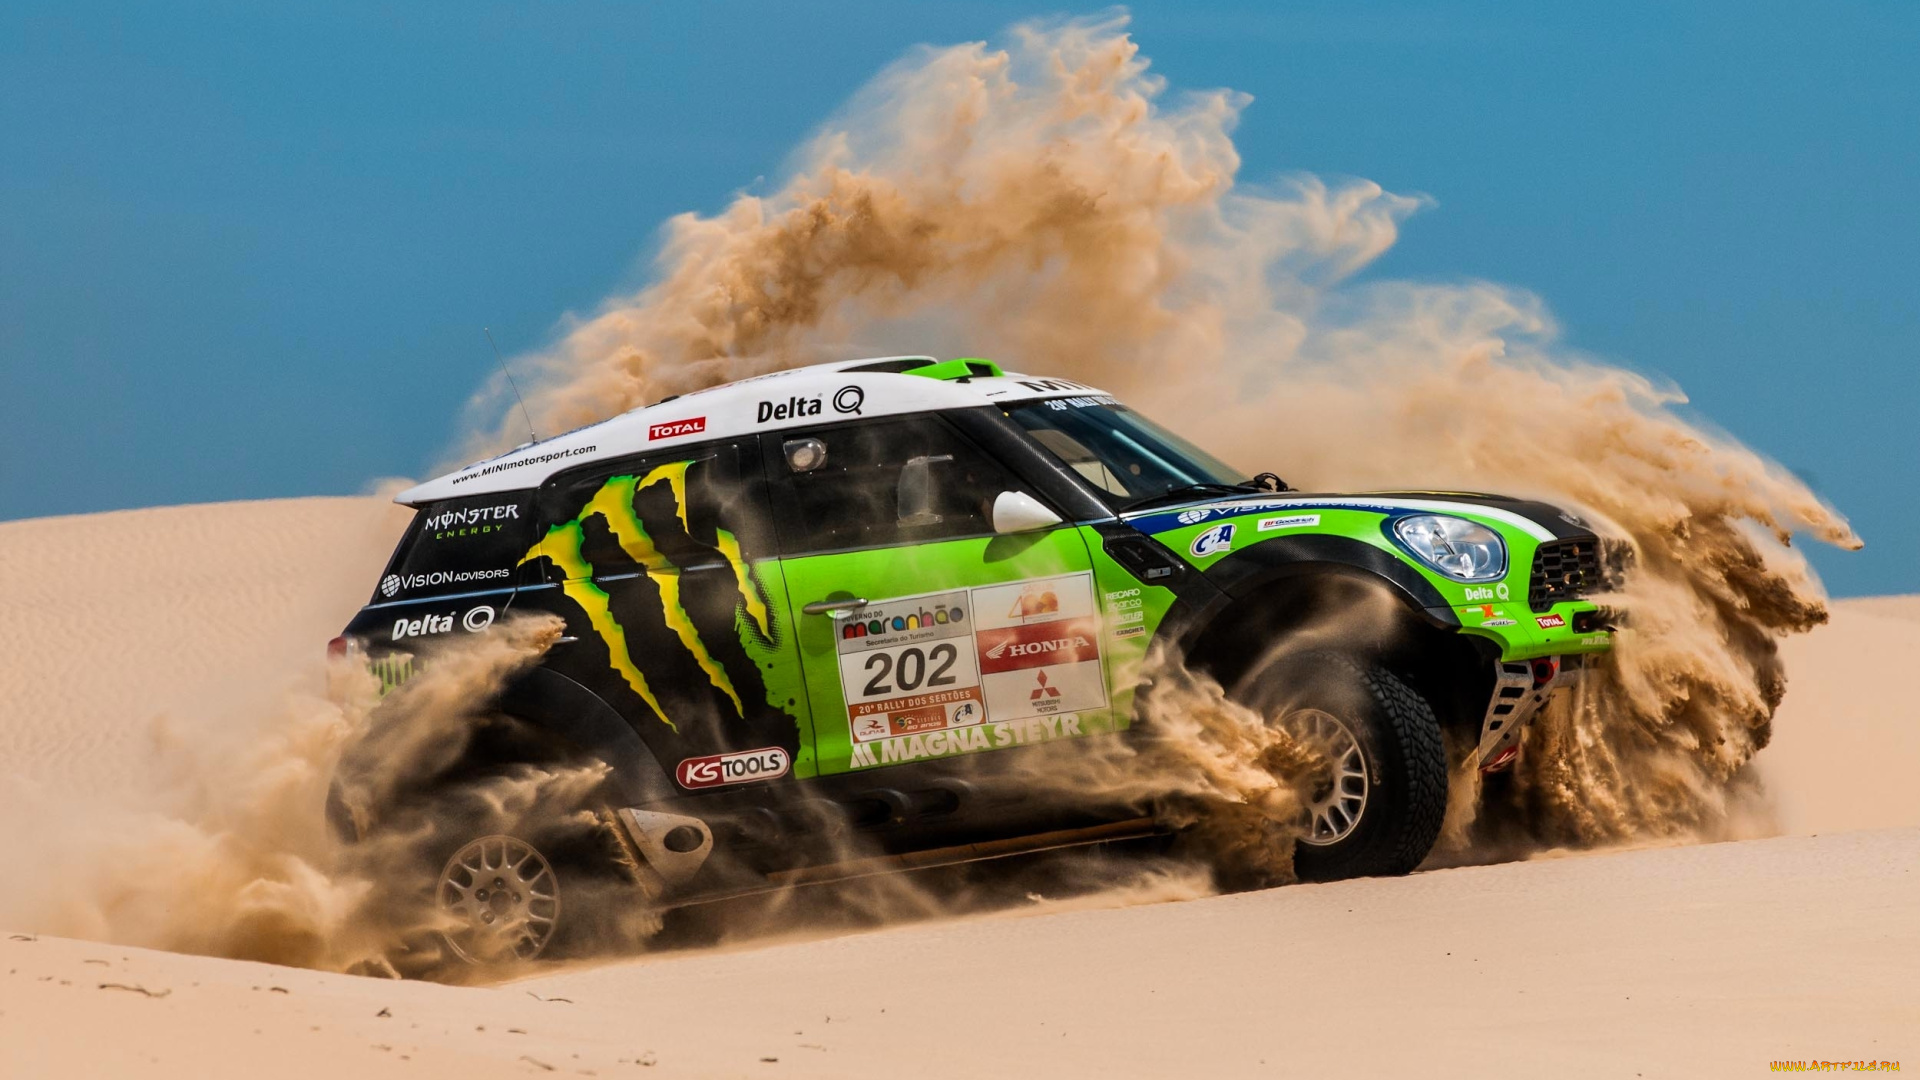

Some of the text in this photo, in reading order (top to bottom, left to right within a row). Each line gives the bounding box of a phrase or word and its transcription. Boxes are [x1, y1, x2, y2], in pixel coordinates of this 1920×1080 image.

[757, 396, 822, 423] Delta
[452, 444, 597, 485] www.MINImotorsport.com
[436, 524, 503, 540] ENERGY
[455, 568, 510, 583] ADVISORS
[1105, 588, 1140, 600] RECARO
[1465, 588, 1493, 600] Delta
[391, 613, 453, 641] Delta
[1009, 636, 1090, 657] HONDA
[863, 643, 957, 697] 202
[877, 699, 906, 711] RALLY
[908, 696, 927, 706] DOS
[929, 690, 971, 704] SERTÕES
[881, 714, 1083, 763] MAGNA STEYR
[721, 754, 781, 777] TOOLS
